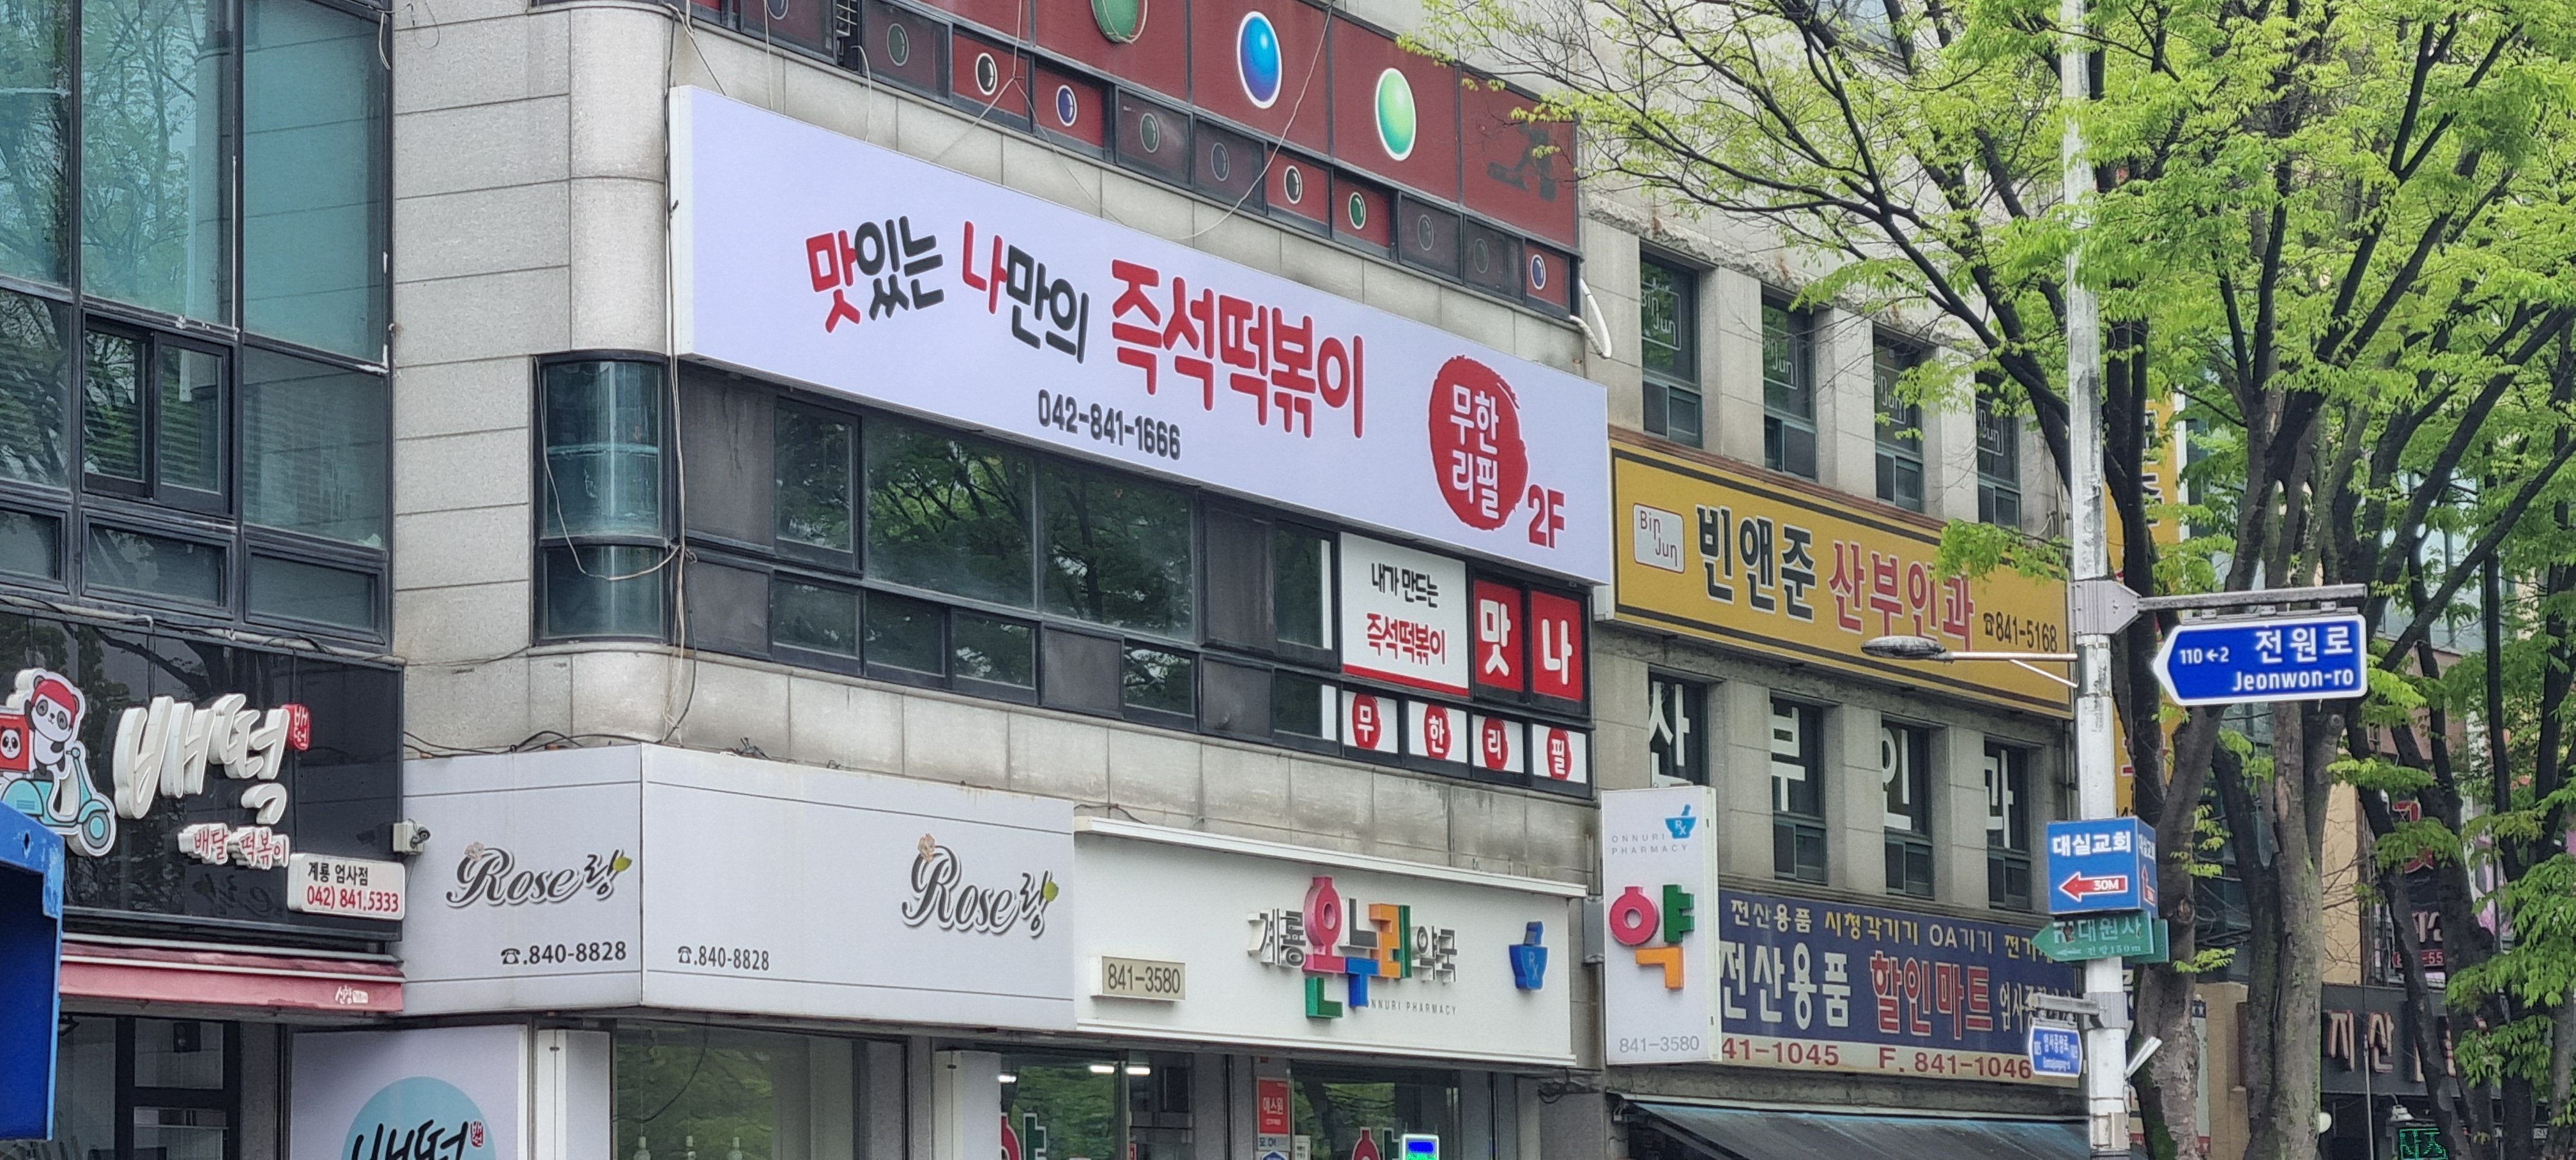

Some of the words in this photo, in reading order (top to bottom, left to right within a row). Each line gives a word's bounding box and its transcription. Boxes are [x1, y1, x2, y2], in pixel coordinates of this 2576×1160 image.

[806, 215, 944, 333] 맛있는
[962, 220, 1089, 363] 나만의
[1112, 259, 1363, 439] 즉석떡볶이
[1653, 312, 1676, 346] Jun
[1772, 354, 1794, 385] Jun
[1038, 389, 1181, 461] 042-841-1666
[1450, 384, 1499, 455] 무한
[1452, 450, 1499, 519] 리필
[1528, 485, 1565, 549] 2F
[1640, 510, 1661, 540] Bin
[1654, 537, 1678, 568] Jun
[1371, 563, 1400, 596] 내가
[1401, 569, 1439, 608] 만드는
[1696, 504, 1816, 623] 빈앤준
[1828, 540, 1975, 651] 산부인과
[1367, 613, 1446, 666] 즉석떡볶이
[1480, 599, 1512, 677] 맛
[1542, 618, 1573, 685] 나
[2255, 625, 2354, 664] 전원로
[2232, 668, 2354, 692] Jeonwon-ro
[194, 828, 229, 861] 배달
[240, 830, 287, 867] 떡볶이
[1611, 833, 1665, 843] ONNURI
[1611, 844, 1688, 855] PHARMACY
[2052, 831, 2132, 857] 대실교회
[307, 862, 330, 883] 계룡
[335, 864, 369, 886] 엄사점
[2093, 879, 2119, 891] 30M
[307, 885, 335, 909] 042)
[339, 887, 399, 912] 841.5333
[1609, 885, 1695, 989] 약
[1731, 899, 1812, 933] 전산용품
[1825, 911, 1919, 945] 시청각기기
[1929, 924, 1993, 954] OA기기
[2004, 935, 2053, 964] 전기
[1107, 963, 1181, 995] 841-3580
[1720, 941, 1851, 1030] 전산용품
[1869, 949, 1993, 1041] 할인마트
[1367, 998, 1401, 1010] NNURI
[1406, 1000, 1457, 1016] PHARMACY
[1619, 1035, 1700, 1053] 841-3580
[1721, 1037, 1839, 1067] 41-1045
[1879, 1046, 1905, 1072] F.
[1914, 1051, 2032, 1080] 841-1046
